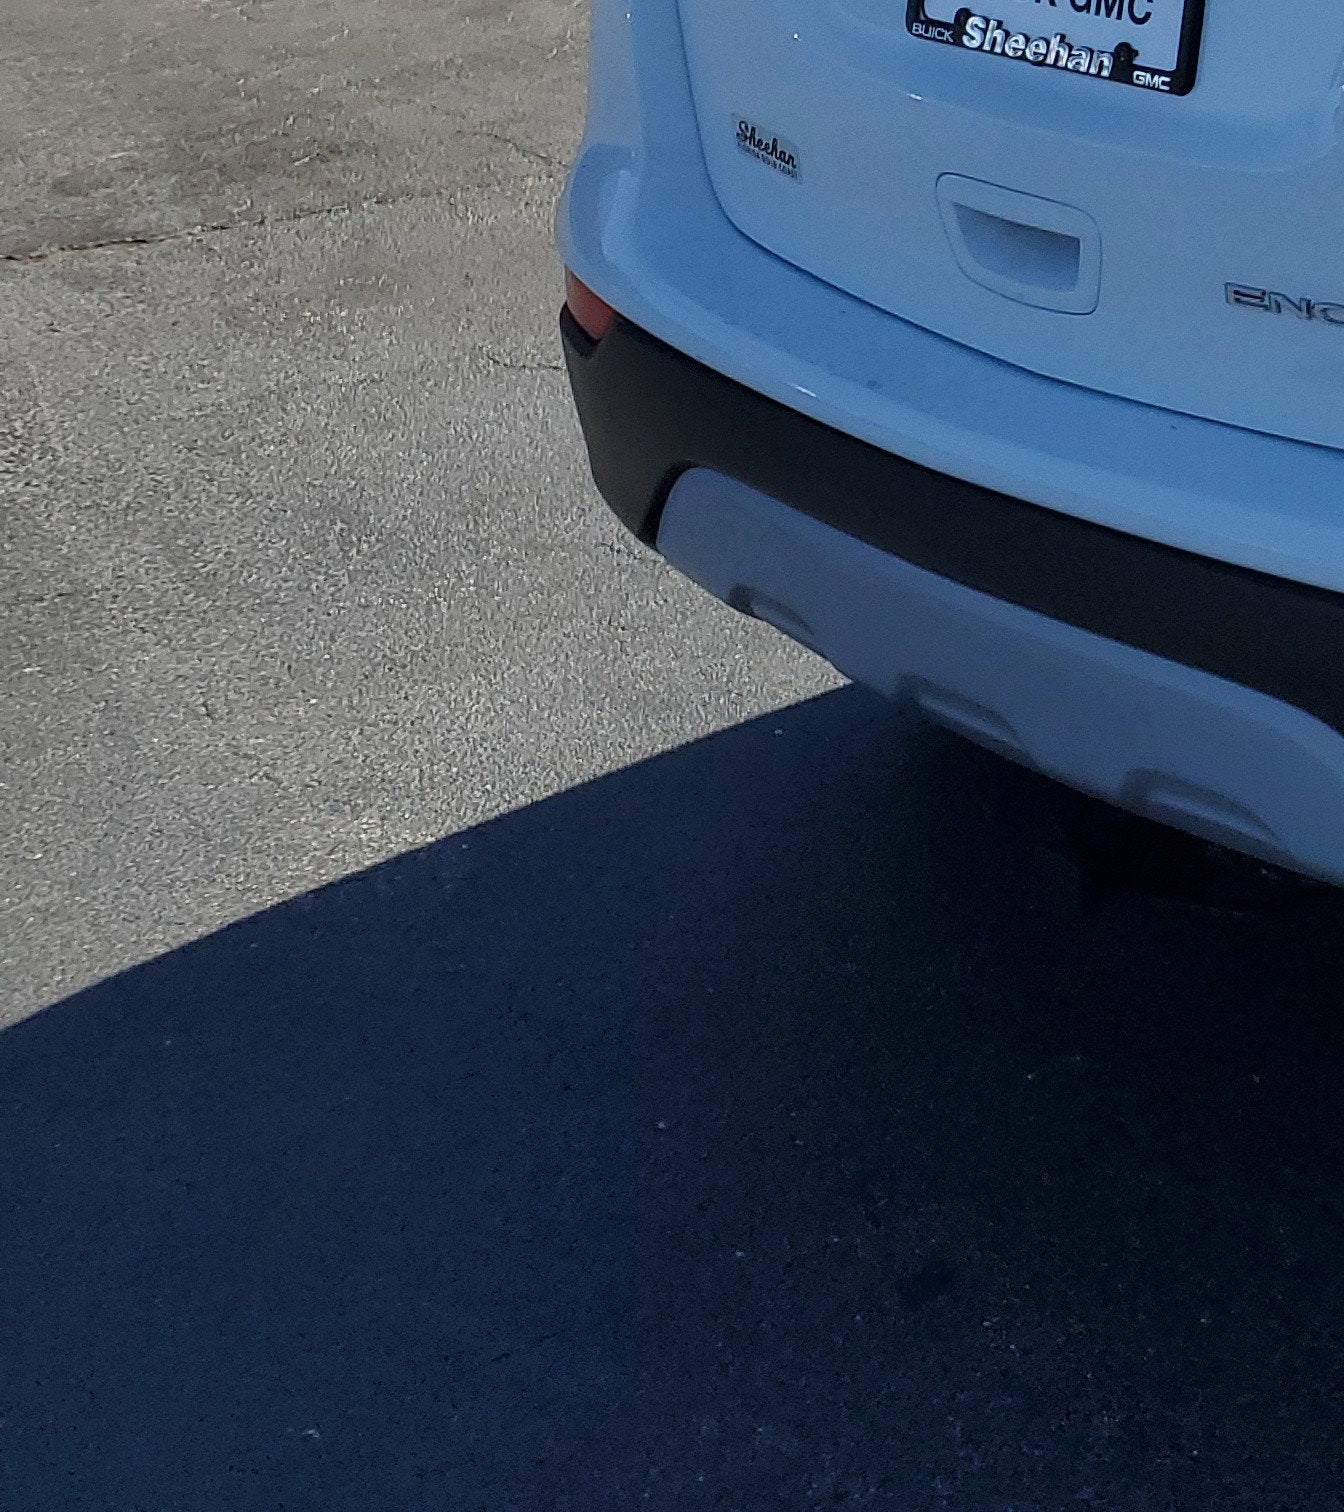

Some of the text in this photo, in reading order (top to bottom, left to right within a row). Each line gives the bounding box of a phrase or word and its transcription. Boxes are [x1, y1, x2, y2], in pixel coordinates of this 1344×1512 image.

[912, 15, 1171, 91] BUICK Sheehan GMC
[736, 120, 797, 169] Sheehan
